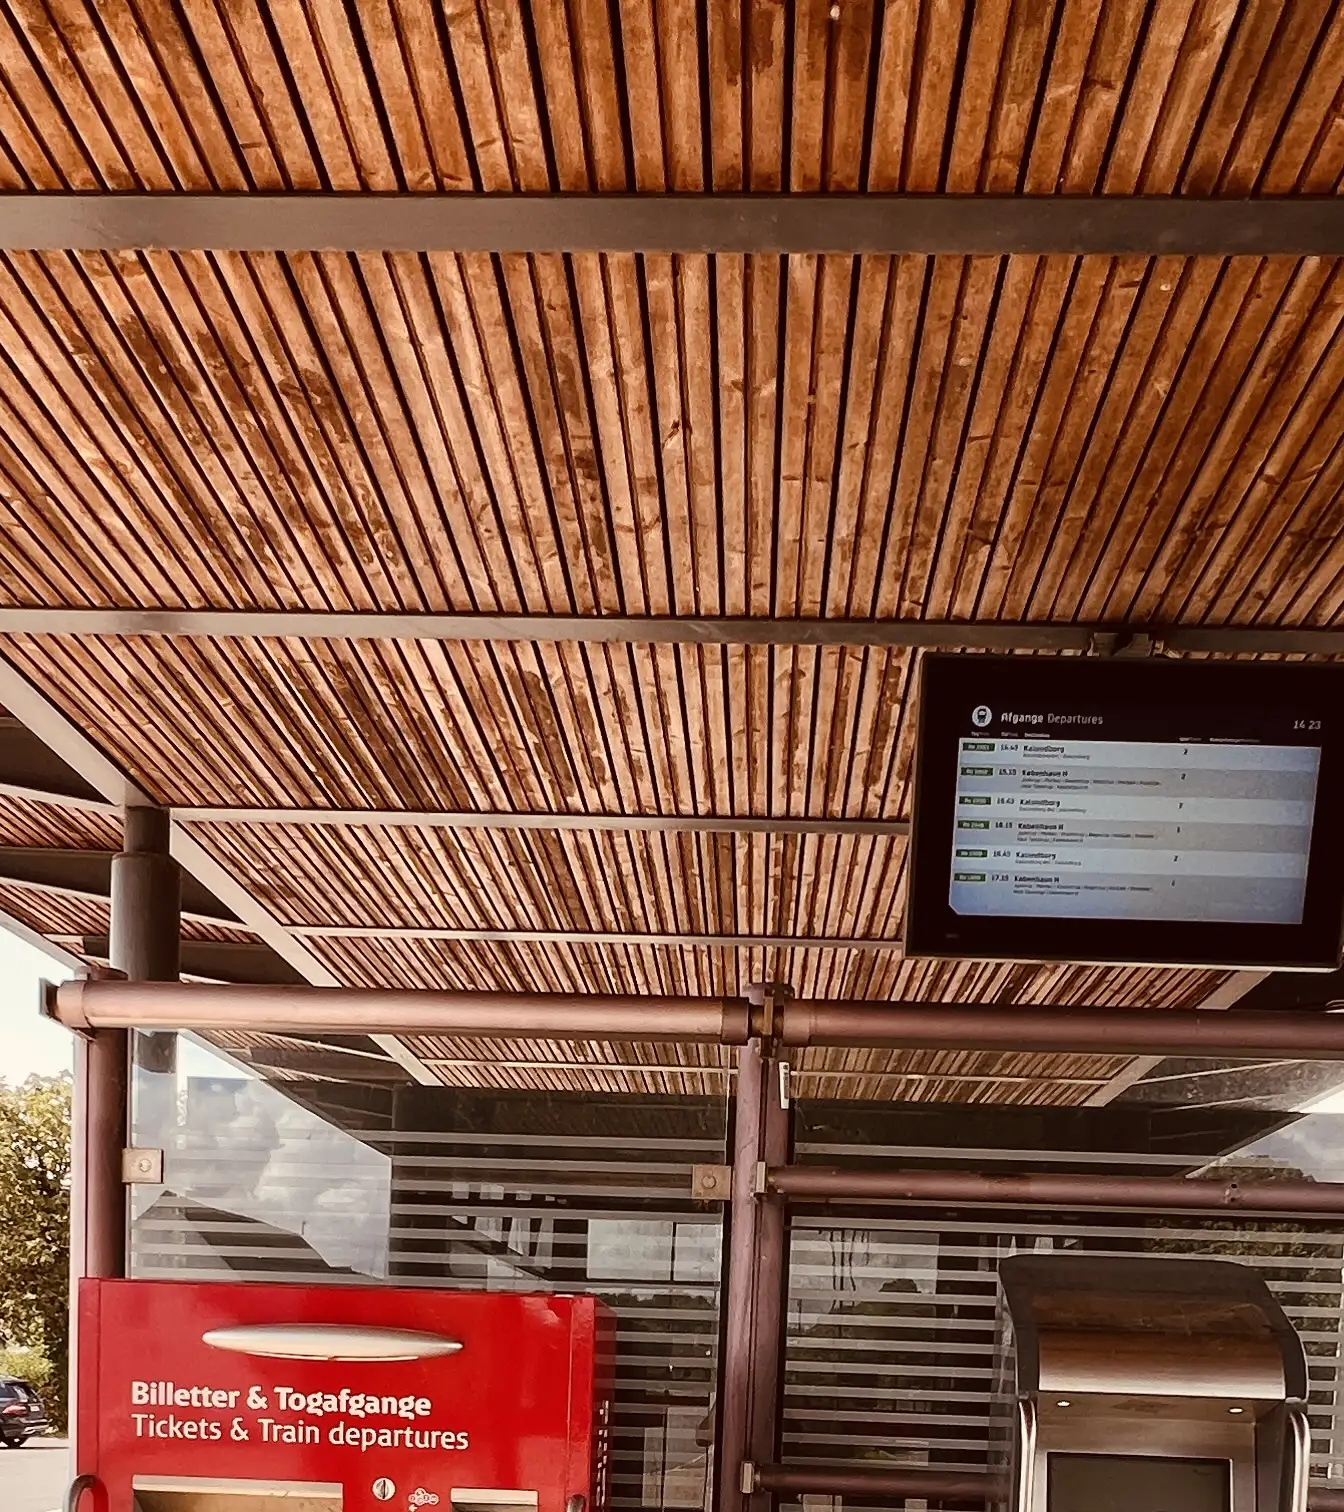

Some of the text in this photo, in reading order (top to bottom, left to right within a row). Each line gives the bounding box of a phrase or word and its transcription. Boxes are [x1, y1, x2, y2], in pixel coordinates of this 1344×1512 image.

[1048, 713, 1104, 725] Departures
[132, 1382, 431, 1420] Billetter & Togafgange
[132, 1414, 468, 1451] Tickets & Train departures
